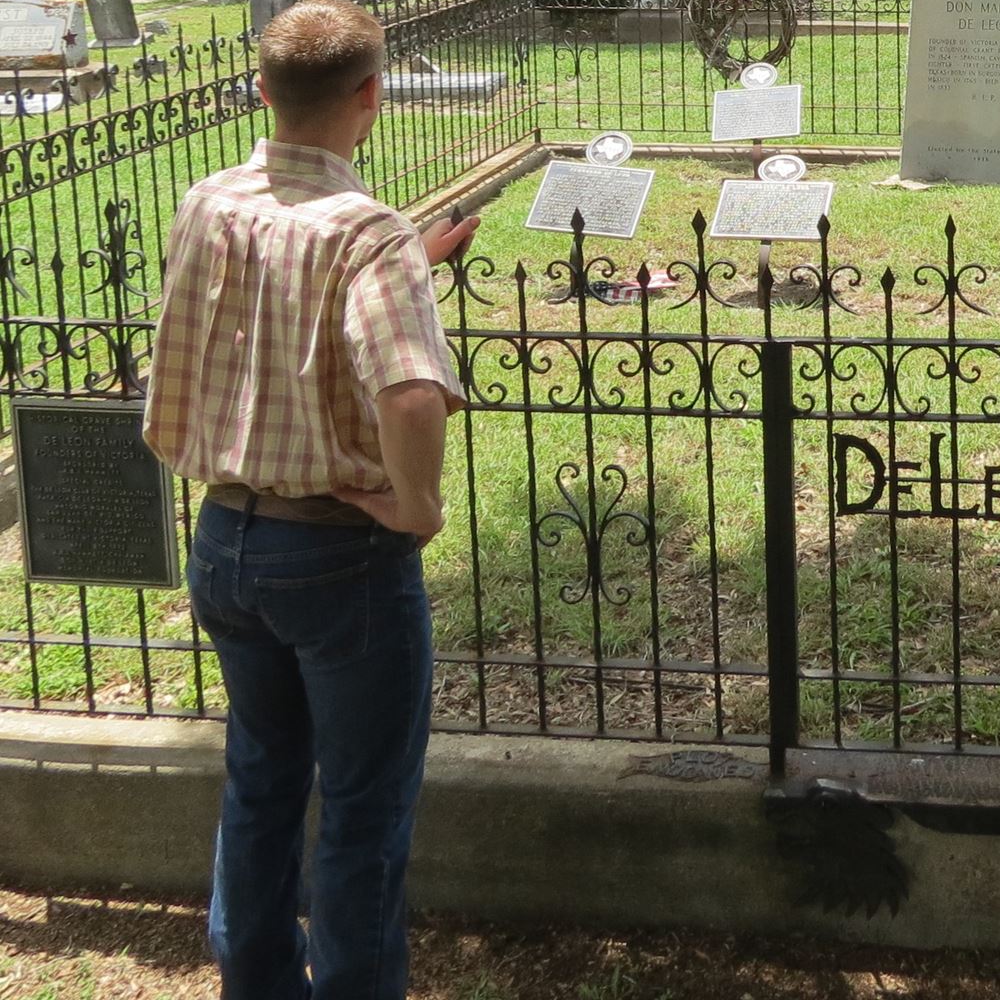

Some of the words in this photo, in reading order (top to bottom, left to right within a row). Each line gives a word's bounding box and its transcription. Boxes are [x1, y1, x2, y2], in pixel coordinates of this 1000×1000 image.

[946, 1, 973, 13] DON
[958, 18, 975, 30] DE
[72, 425, 83, 433] OF
[43, 435, 57, 446] DE
[95, 437, 134, 449] FAMILY
[101, 451, 145, 460] VICTORIA
